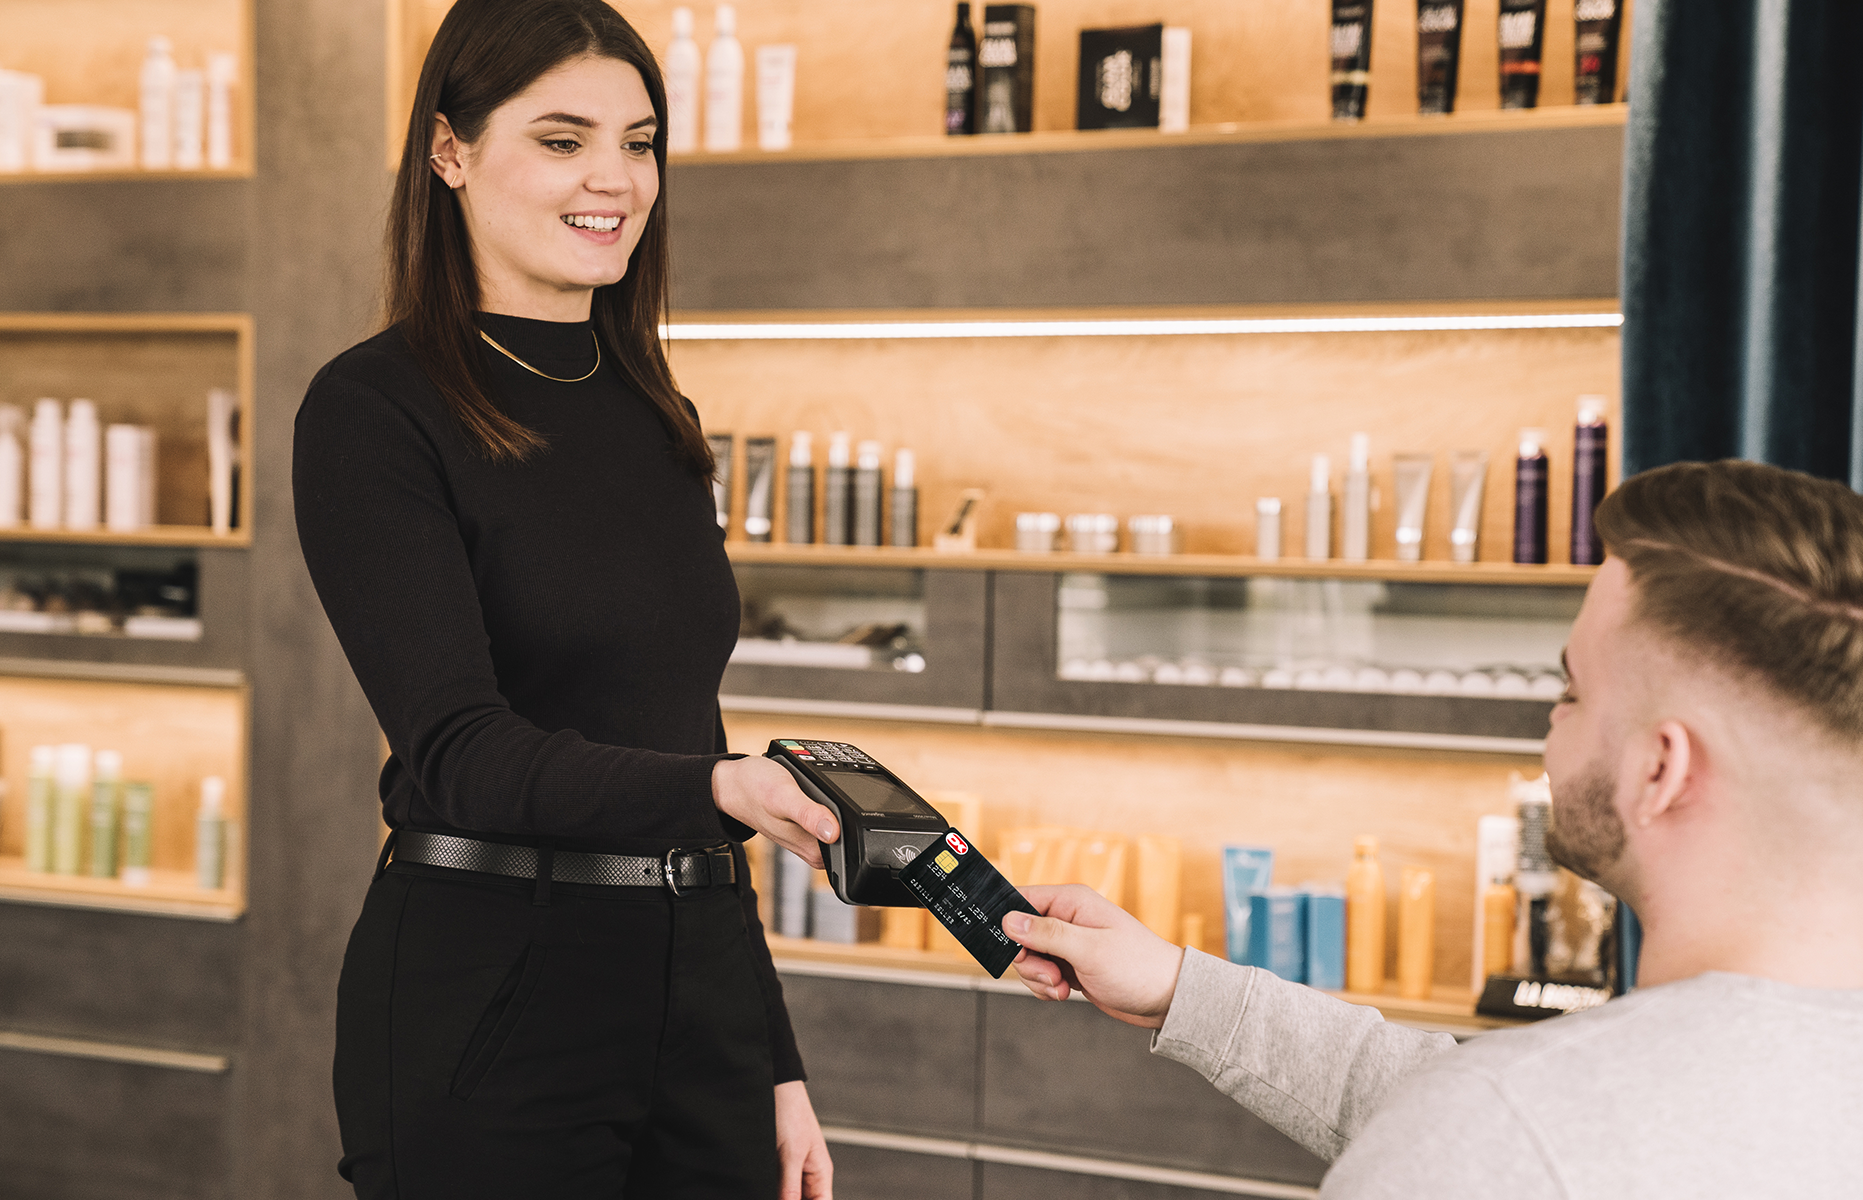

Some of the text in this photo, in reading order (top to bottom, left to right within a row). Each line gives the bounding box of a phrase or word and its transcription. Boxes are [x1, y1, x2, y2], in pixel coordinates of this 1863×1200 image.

[927, 862, 947, 881] 1234
[947, 883, 968, 902] 1234
[968, 904, 989, 924] 1234
[989, 925, 1010, 946] 1234
